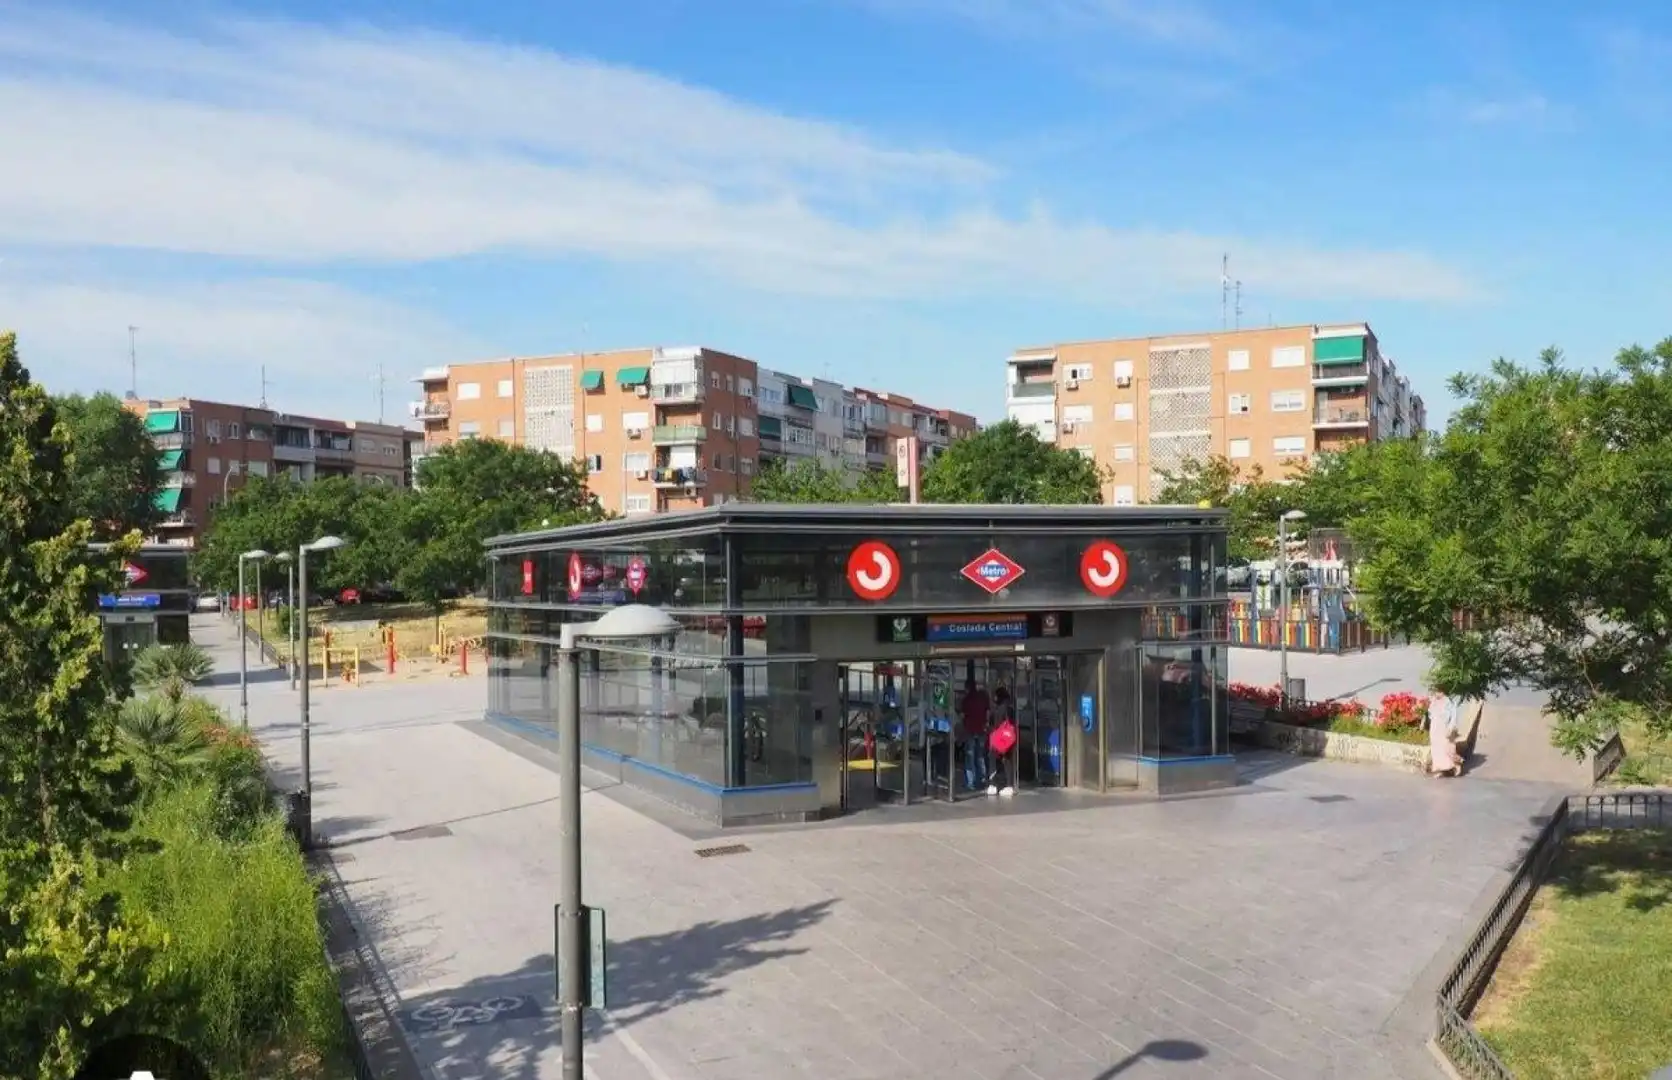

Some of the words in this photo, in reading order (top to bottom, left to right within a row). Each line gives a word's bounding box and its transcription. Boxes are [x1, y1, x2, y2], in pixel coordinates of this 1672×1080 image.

[980, 564, 1007, 576] Metro
[949, 623, 986, 633] Coslada
[988, 622, 1022, 632] Central
